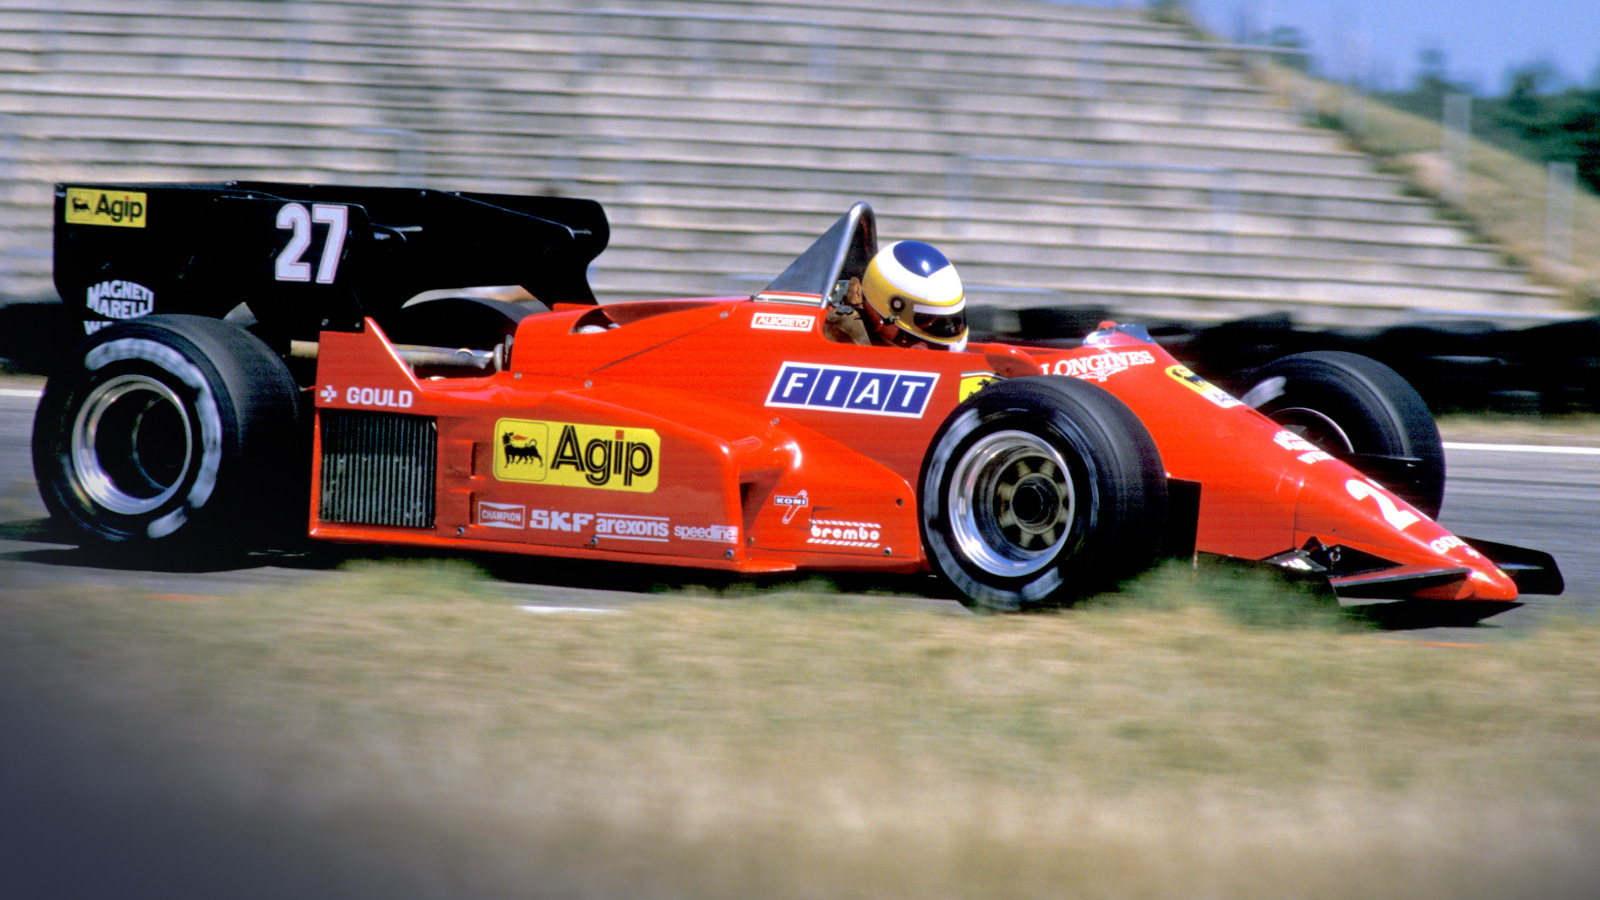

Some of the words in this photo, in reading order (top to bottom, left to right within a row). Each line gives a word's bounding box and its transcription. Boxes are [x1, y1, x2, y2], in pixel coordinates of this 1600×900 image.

[95, 193, 143, 223] Agip
[275, 202, 349, 284] 27
[86, 279, 154, 301] MAGNETI
[757, 316, 809, 328] ALBORETO
[1040, 350, 1155, 376] LONGINES
[346, 386, 413, 408] GOULD
[782, 373, 926, 407] FIAT
[550, 425, 653, 487] Agip
[776, 496, 807, 506] KONI
[481, 509, 522, 522] CHAMPION
[529, 509, 594, 533] SKF
[595, 516, 670, 537] arexons
[673, 525, 739, 543] speedline
[810, 524, 880, 541] brembo
